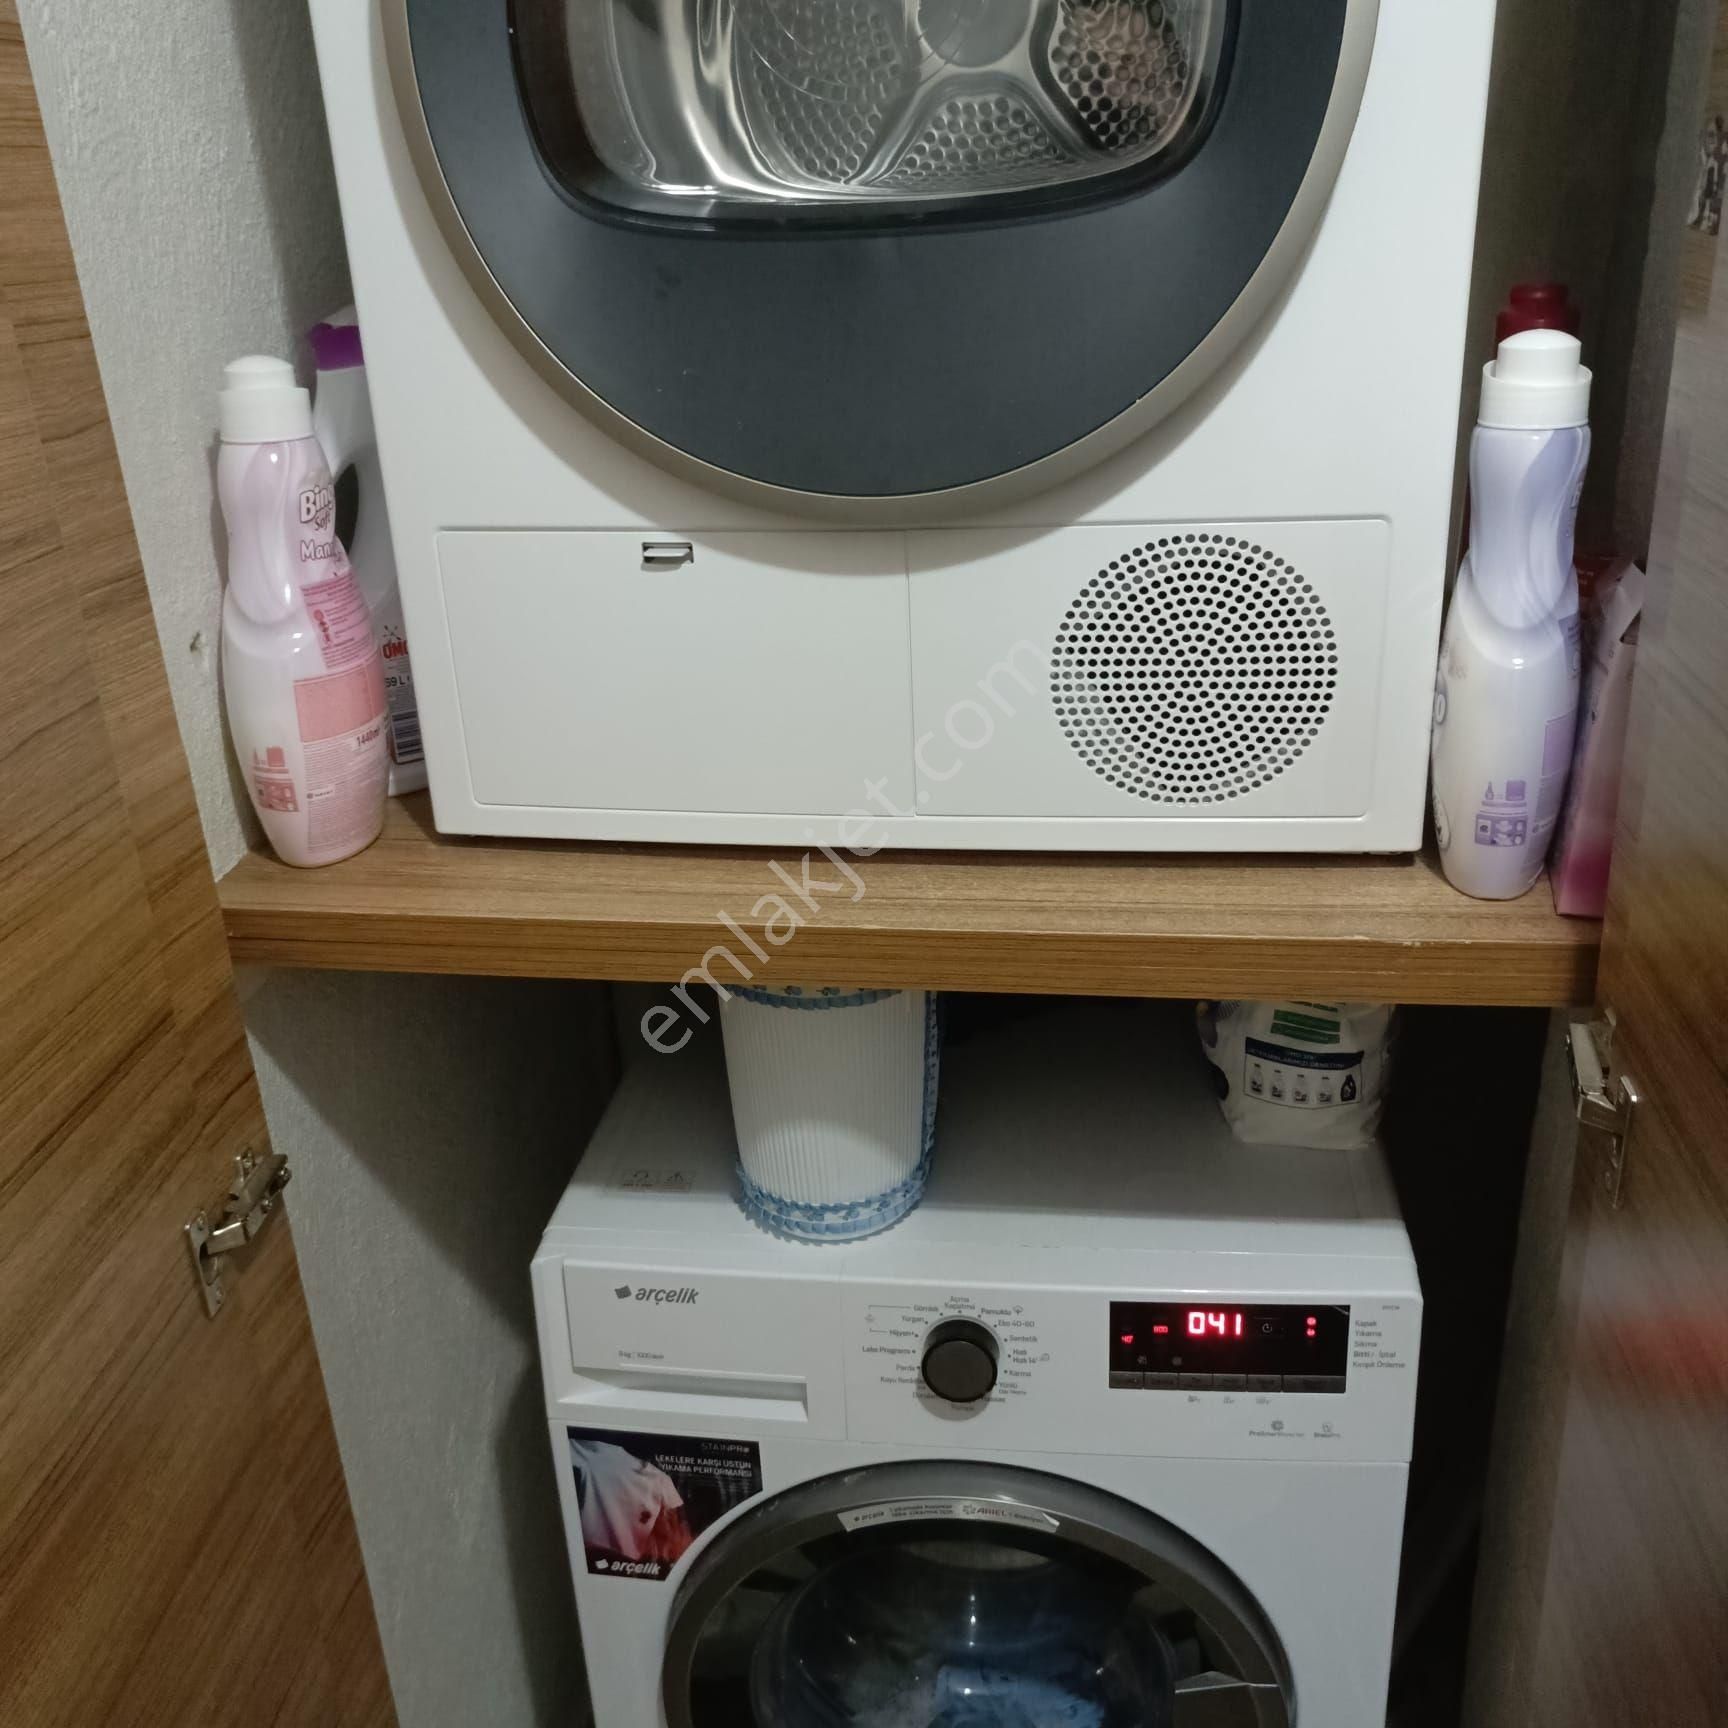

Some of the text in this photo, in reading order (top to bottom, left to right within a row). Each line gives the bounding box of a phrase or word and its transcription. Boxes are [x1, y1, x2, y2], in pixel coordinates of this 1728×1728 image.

[634, 1287, 699, 1306] arçelik
[1188, 1311, 1242, 1335] 041
[610, 1560, 661, 1576] arçelik
